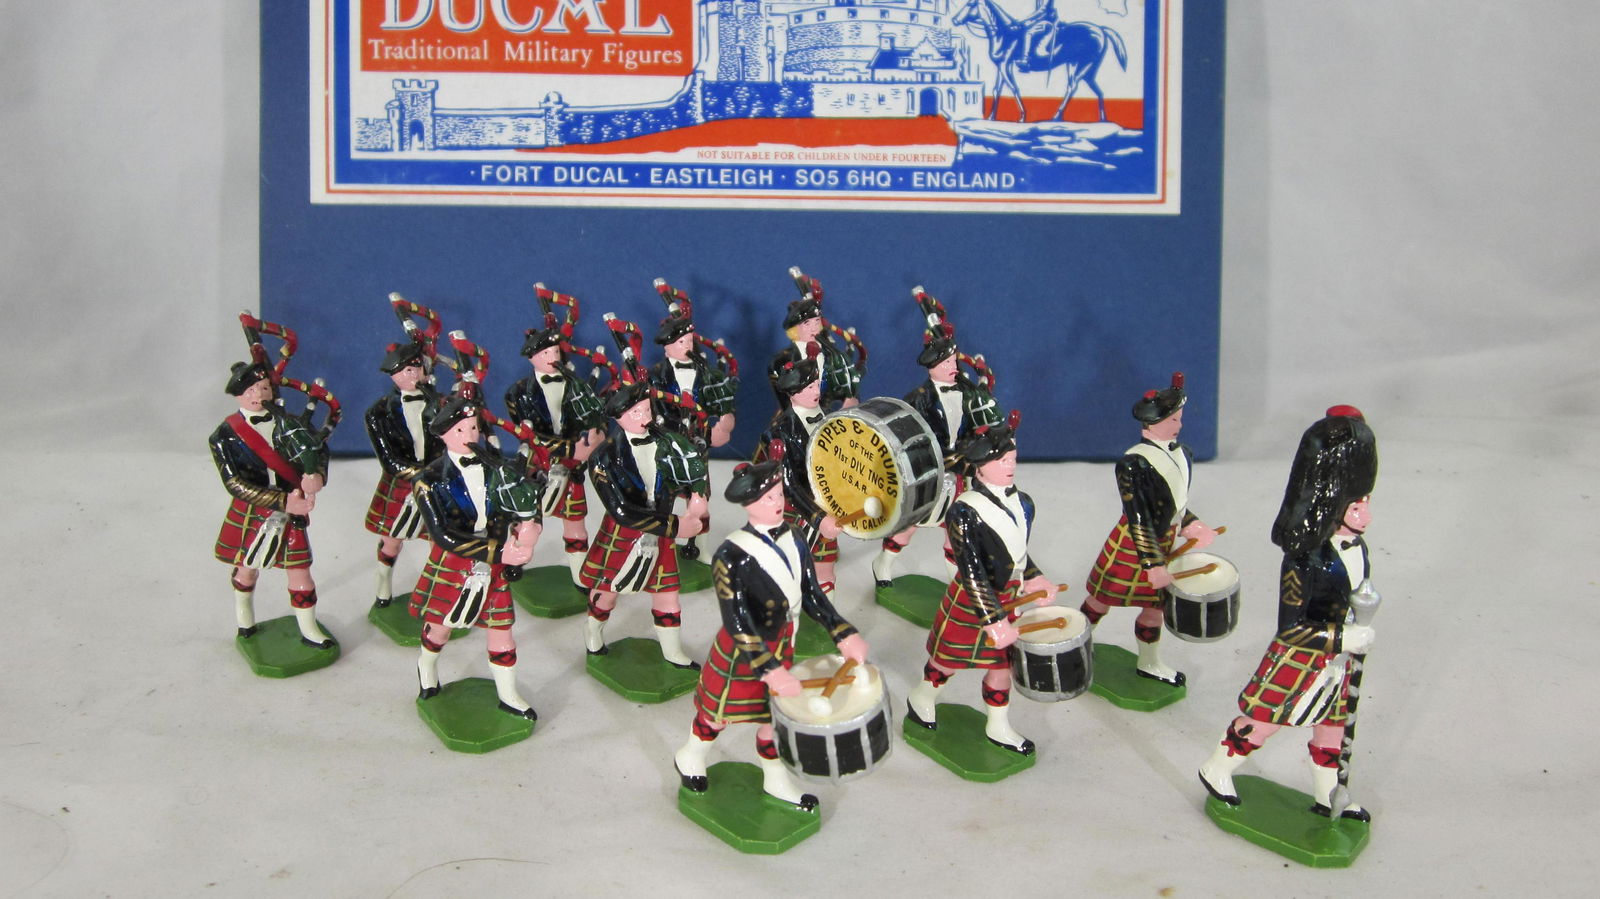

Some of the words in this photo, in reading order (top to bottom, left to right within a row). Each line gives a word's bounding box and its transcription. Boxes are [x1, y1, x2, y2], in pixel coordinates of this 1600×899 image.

[379, 0, 673, 36] DUCAL
[368, 38, 489, 61] Traditional
[504, 40, 592, 69] Military
[603, 43, 683, 69] Figures
[697, 150, 718, 159] NOT
[721, 151, 771, 160] SUITABLE
[774, 151, 795, 160] FOR
[798, 151, 850, 161] CHILDREN
[854, 152, 889, 162] UNDER
[892, 153, 947, 163] FOURTEEN
[481, 165, 543, 183] FORT
[553, 166, 629, 184] DUCAL
[651, 167, 773, 186] EASTLEIGH
[795, 169, 839, 186] SO5
[847, 170, 892, 187] 6HQ
[913, 171, 1016, 189] ENGLAND
[817, 419, 847, 452] PIPES
[852, 420, 864, 435] &
[870, 433, 898, 498] DRUMS
[849, 439, 859, 451] OF
[861, 447, 874, 461] THE
[841, 470, 868, 496] U.S.A.R.
[850, 456, 866, 477] DIV.
[868, 468, 886, 492] TNG.
[815, 465, 859, 530] SACRAMENO,
